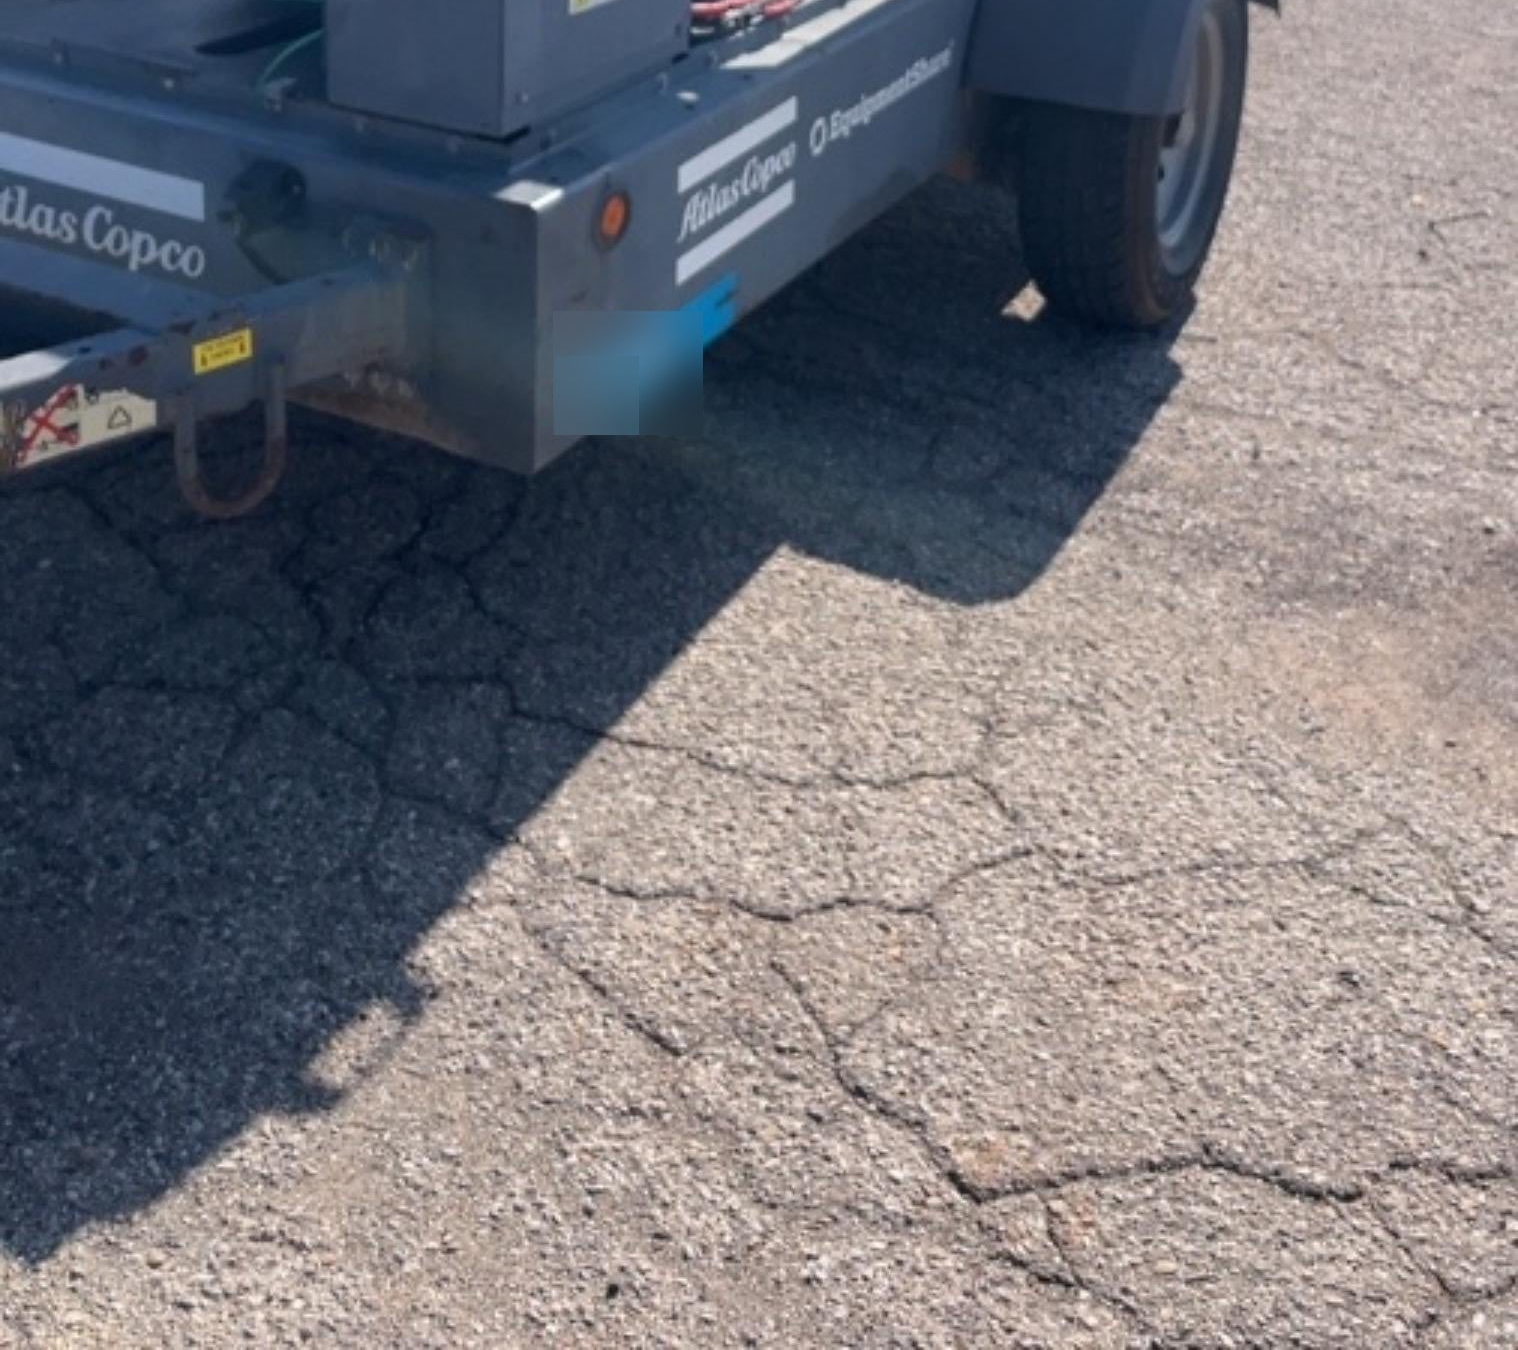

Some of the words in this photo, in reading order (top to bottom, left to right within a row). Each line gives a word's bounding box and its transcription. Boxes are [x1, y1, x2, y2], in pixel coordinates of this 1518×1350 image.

[829, 46, 952, 141] EquipmentShare
[677, 180, 740, 243] Atlas
[741, 140, 797, 196] Copco
[82, 205, 205, 277] Copco
